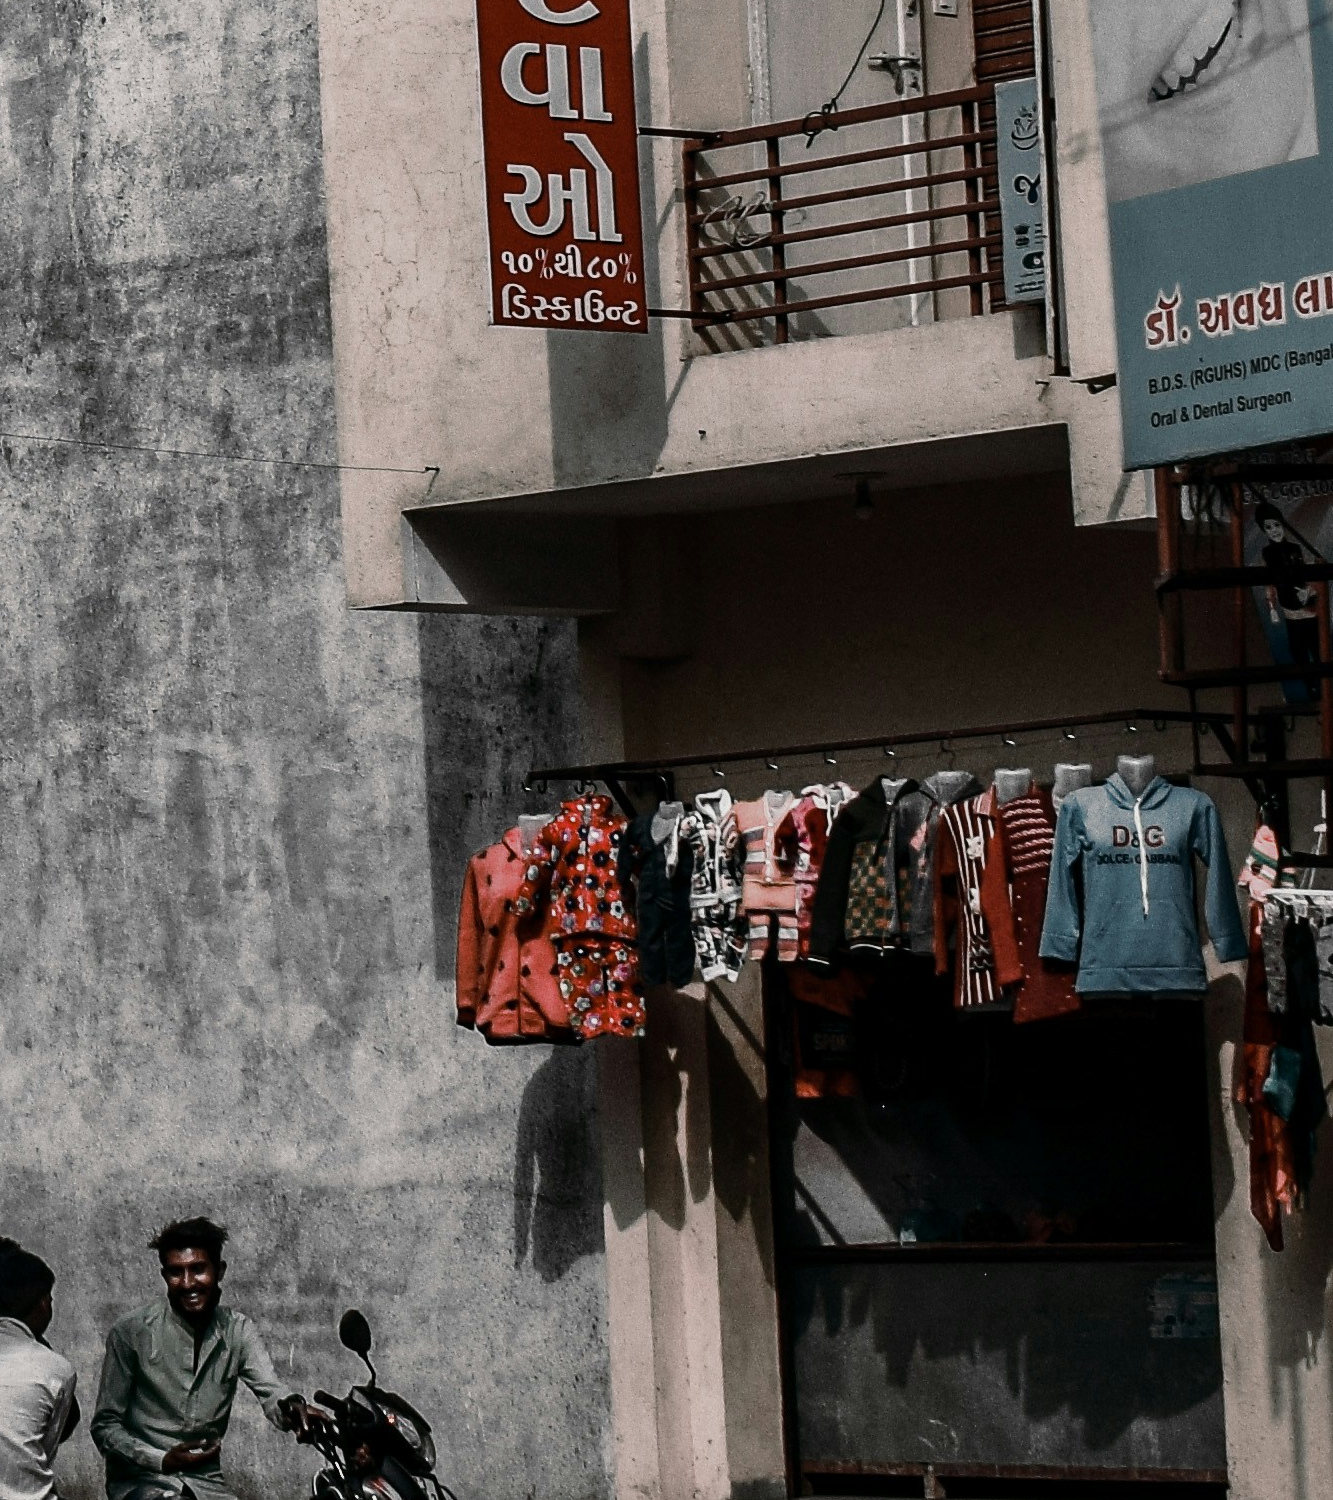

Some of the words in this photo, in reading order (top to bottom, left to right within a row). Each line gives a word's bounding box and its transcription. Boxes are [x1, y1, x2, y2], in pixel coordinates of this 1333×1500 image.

[501, 283, 641, 326] ડિસ્કાઉન્ટ
[1293, 273, 1333, 318] લા
[1148, 373, 1187, 394] B.D.S.
[1190, 360, 1247, 390] (RGUHS)
[1250, 354, 1281, 375] MDC
[1284, 343, 1333, 372] (Bangal
[1150, 408, 1177, 428] Oral
[1180, 406, 1190, 422] &
[1193, 398, 1233, 421] Dental
[1237, 390, 1292, 412] Surgeon
[1112, 825, 1166, 848] D&G
